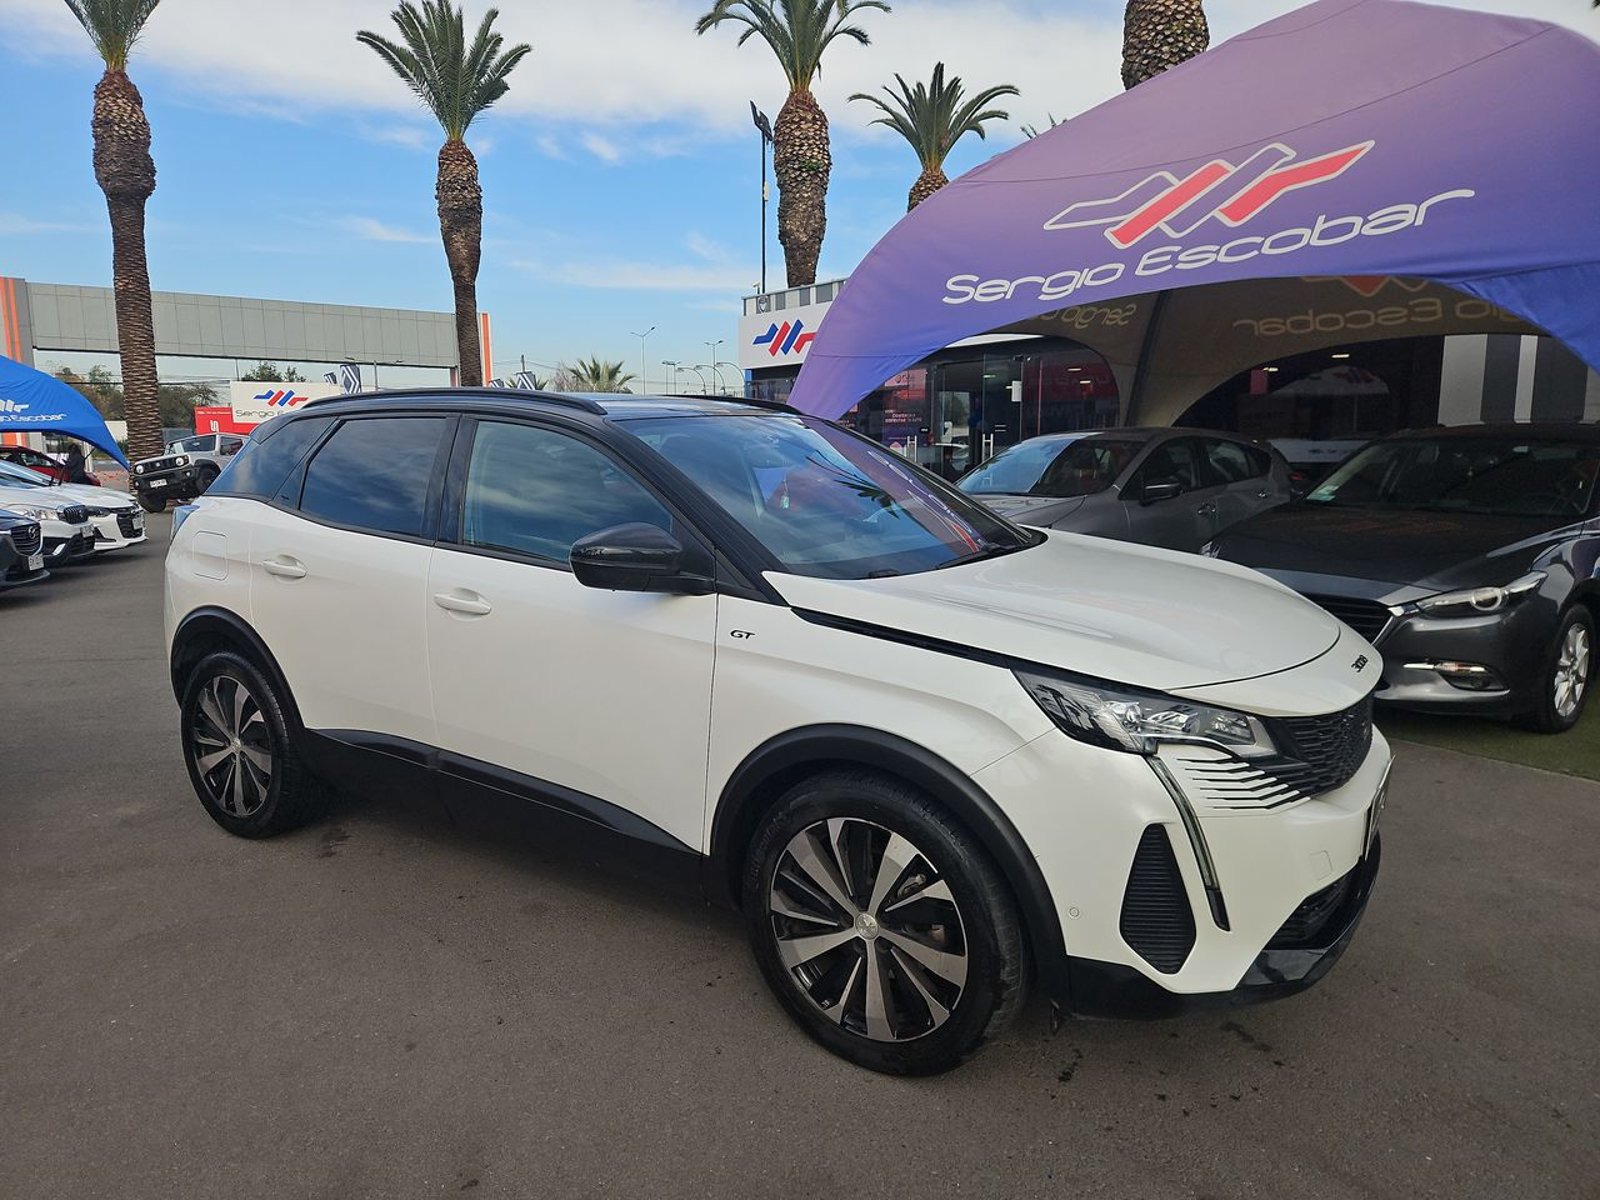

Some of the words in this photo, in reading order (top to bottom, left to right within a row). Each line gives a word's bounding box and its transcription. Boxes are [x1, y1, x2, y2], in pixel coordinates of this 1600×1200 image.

[942, 263, 1125, 304] Sergio
[1135, 189, 1476, 276] Escobar
[730, 629, 756, 640] GT
